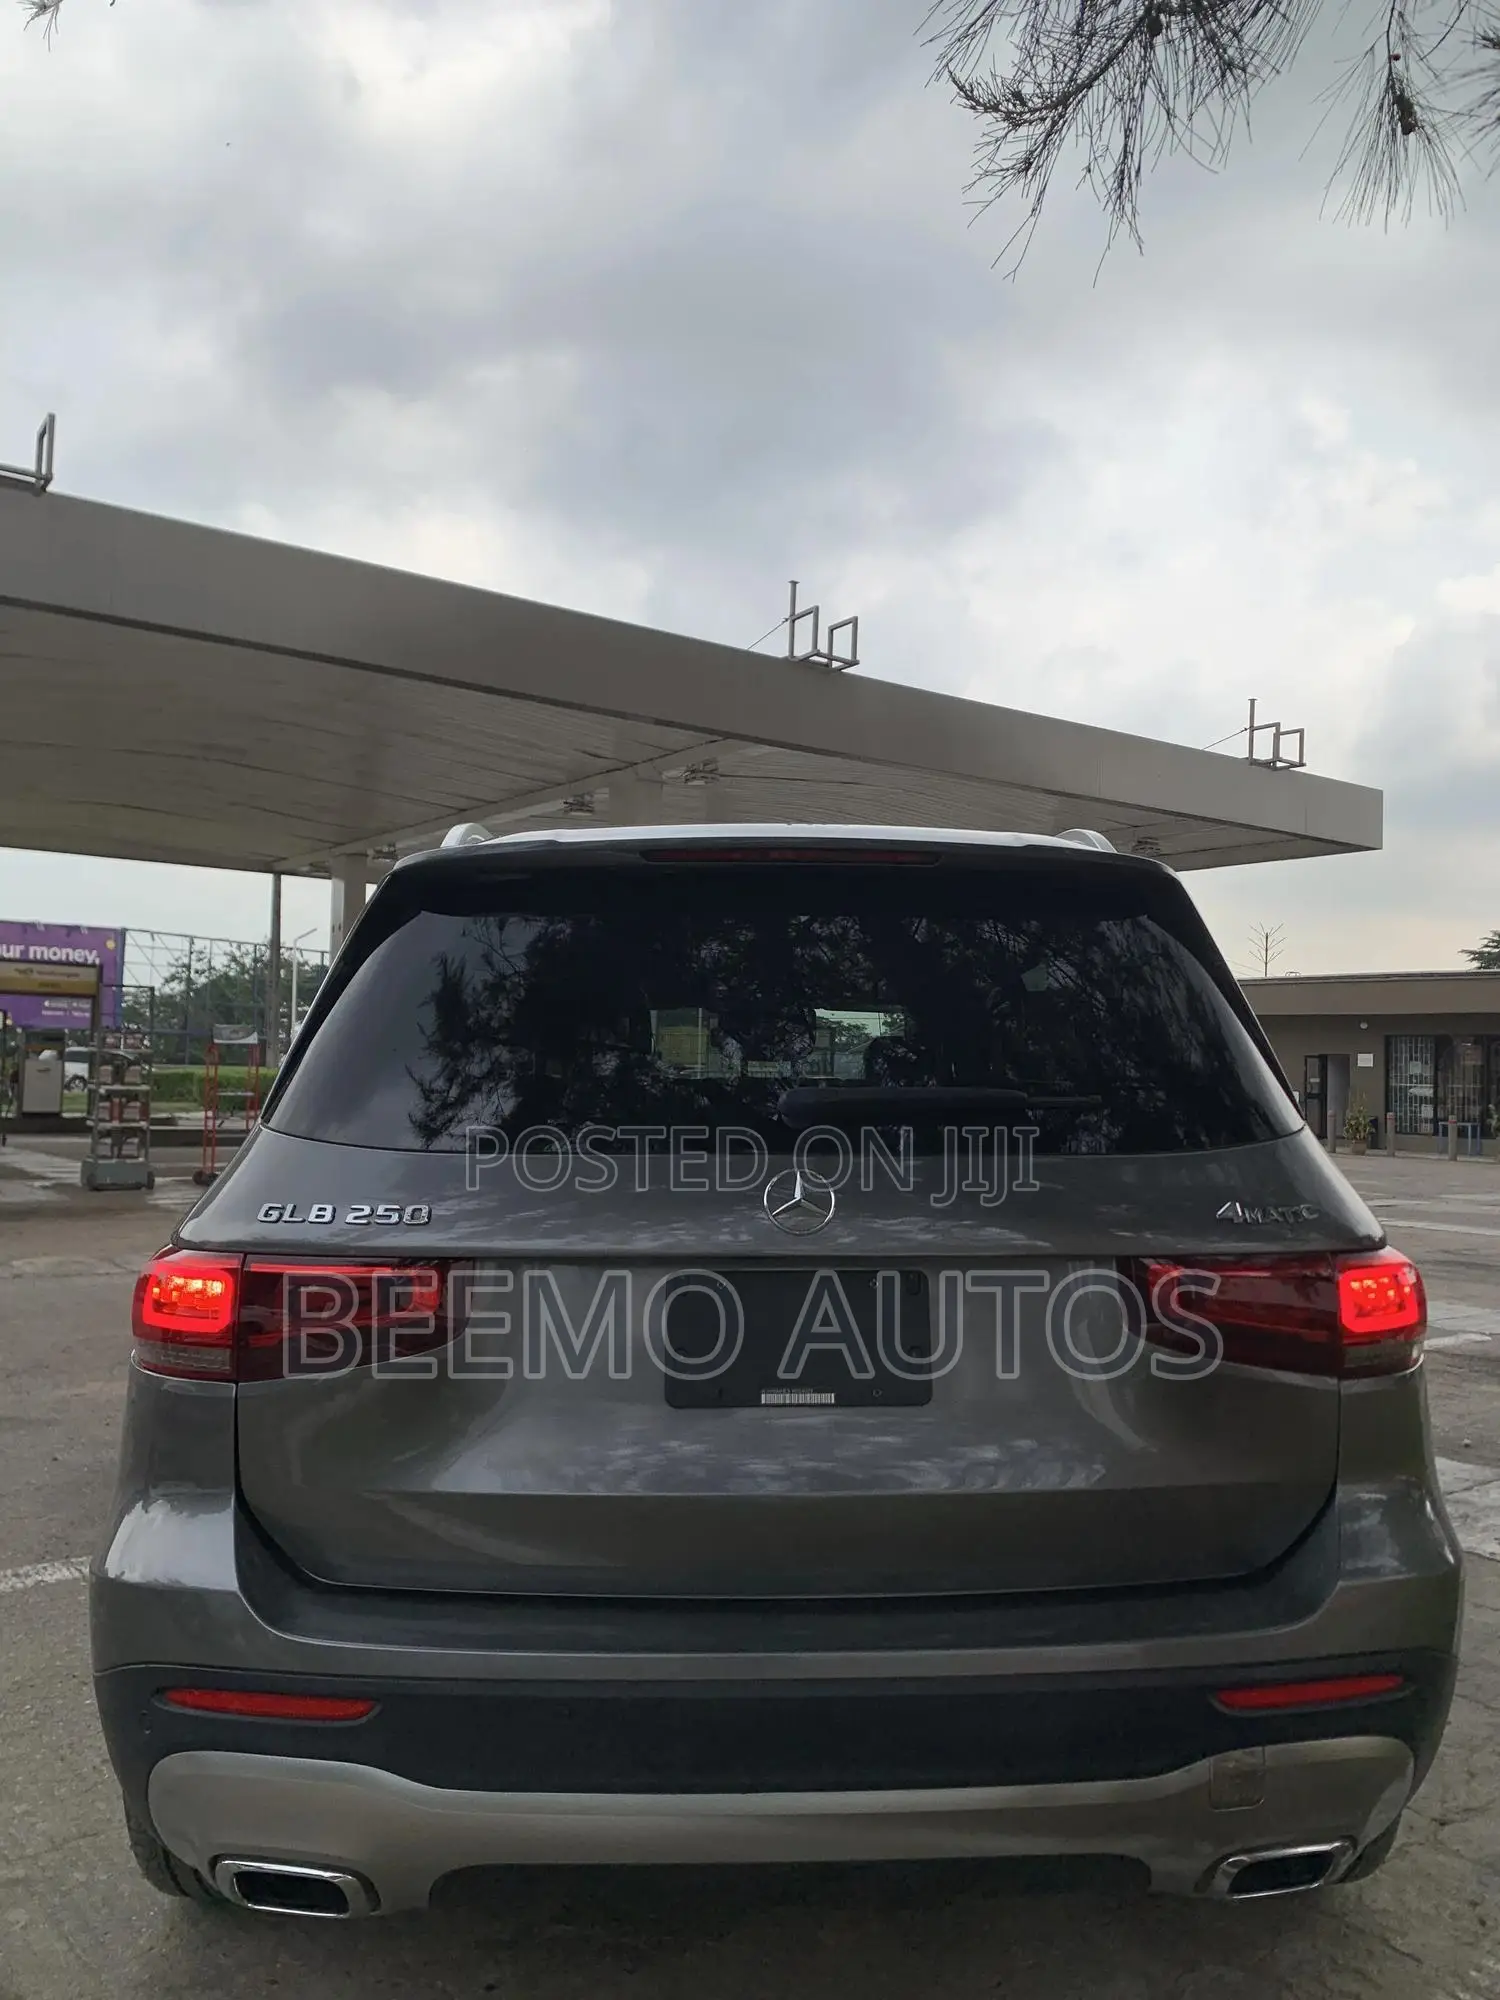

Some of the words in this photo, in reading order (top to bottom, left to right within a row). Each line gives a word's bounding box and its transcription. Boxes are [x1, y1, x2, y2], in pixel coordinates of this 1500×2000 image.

[0, 943, 25, 958] ur
[257, 1203, 335, 1224] GLB
[345, 1204, 431, 1225] 250
